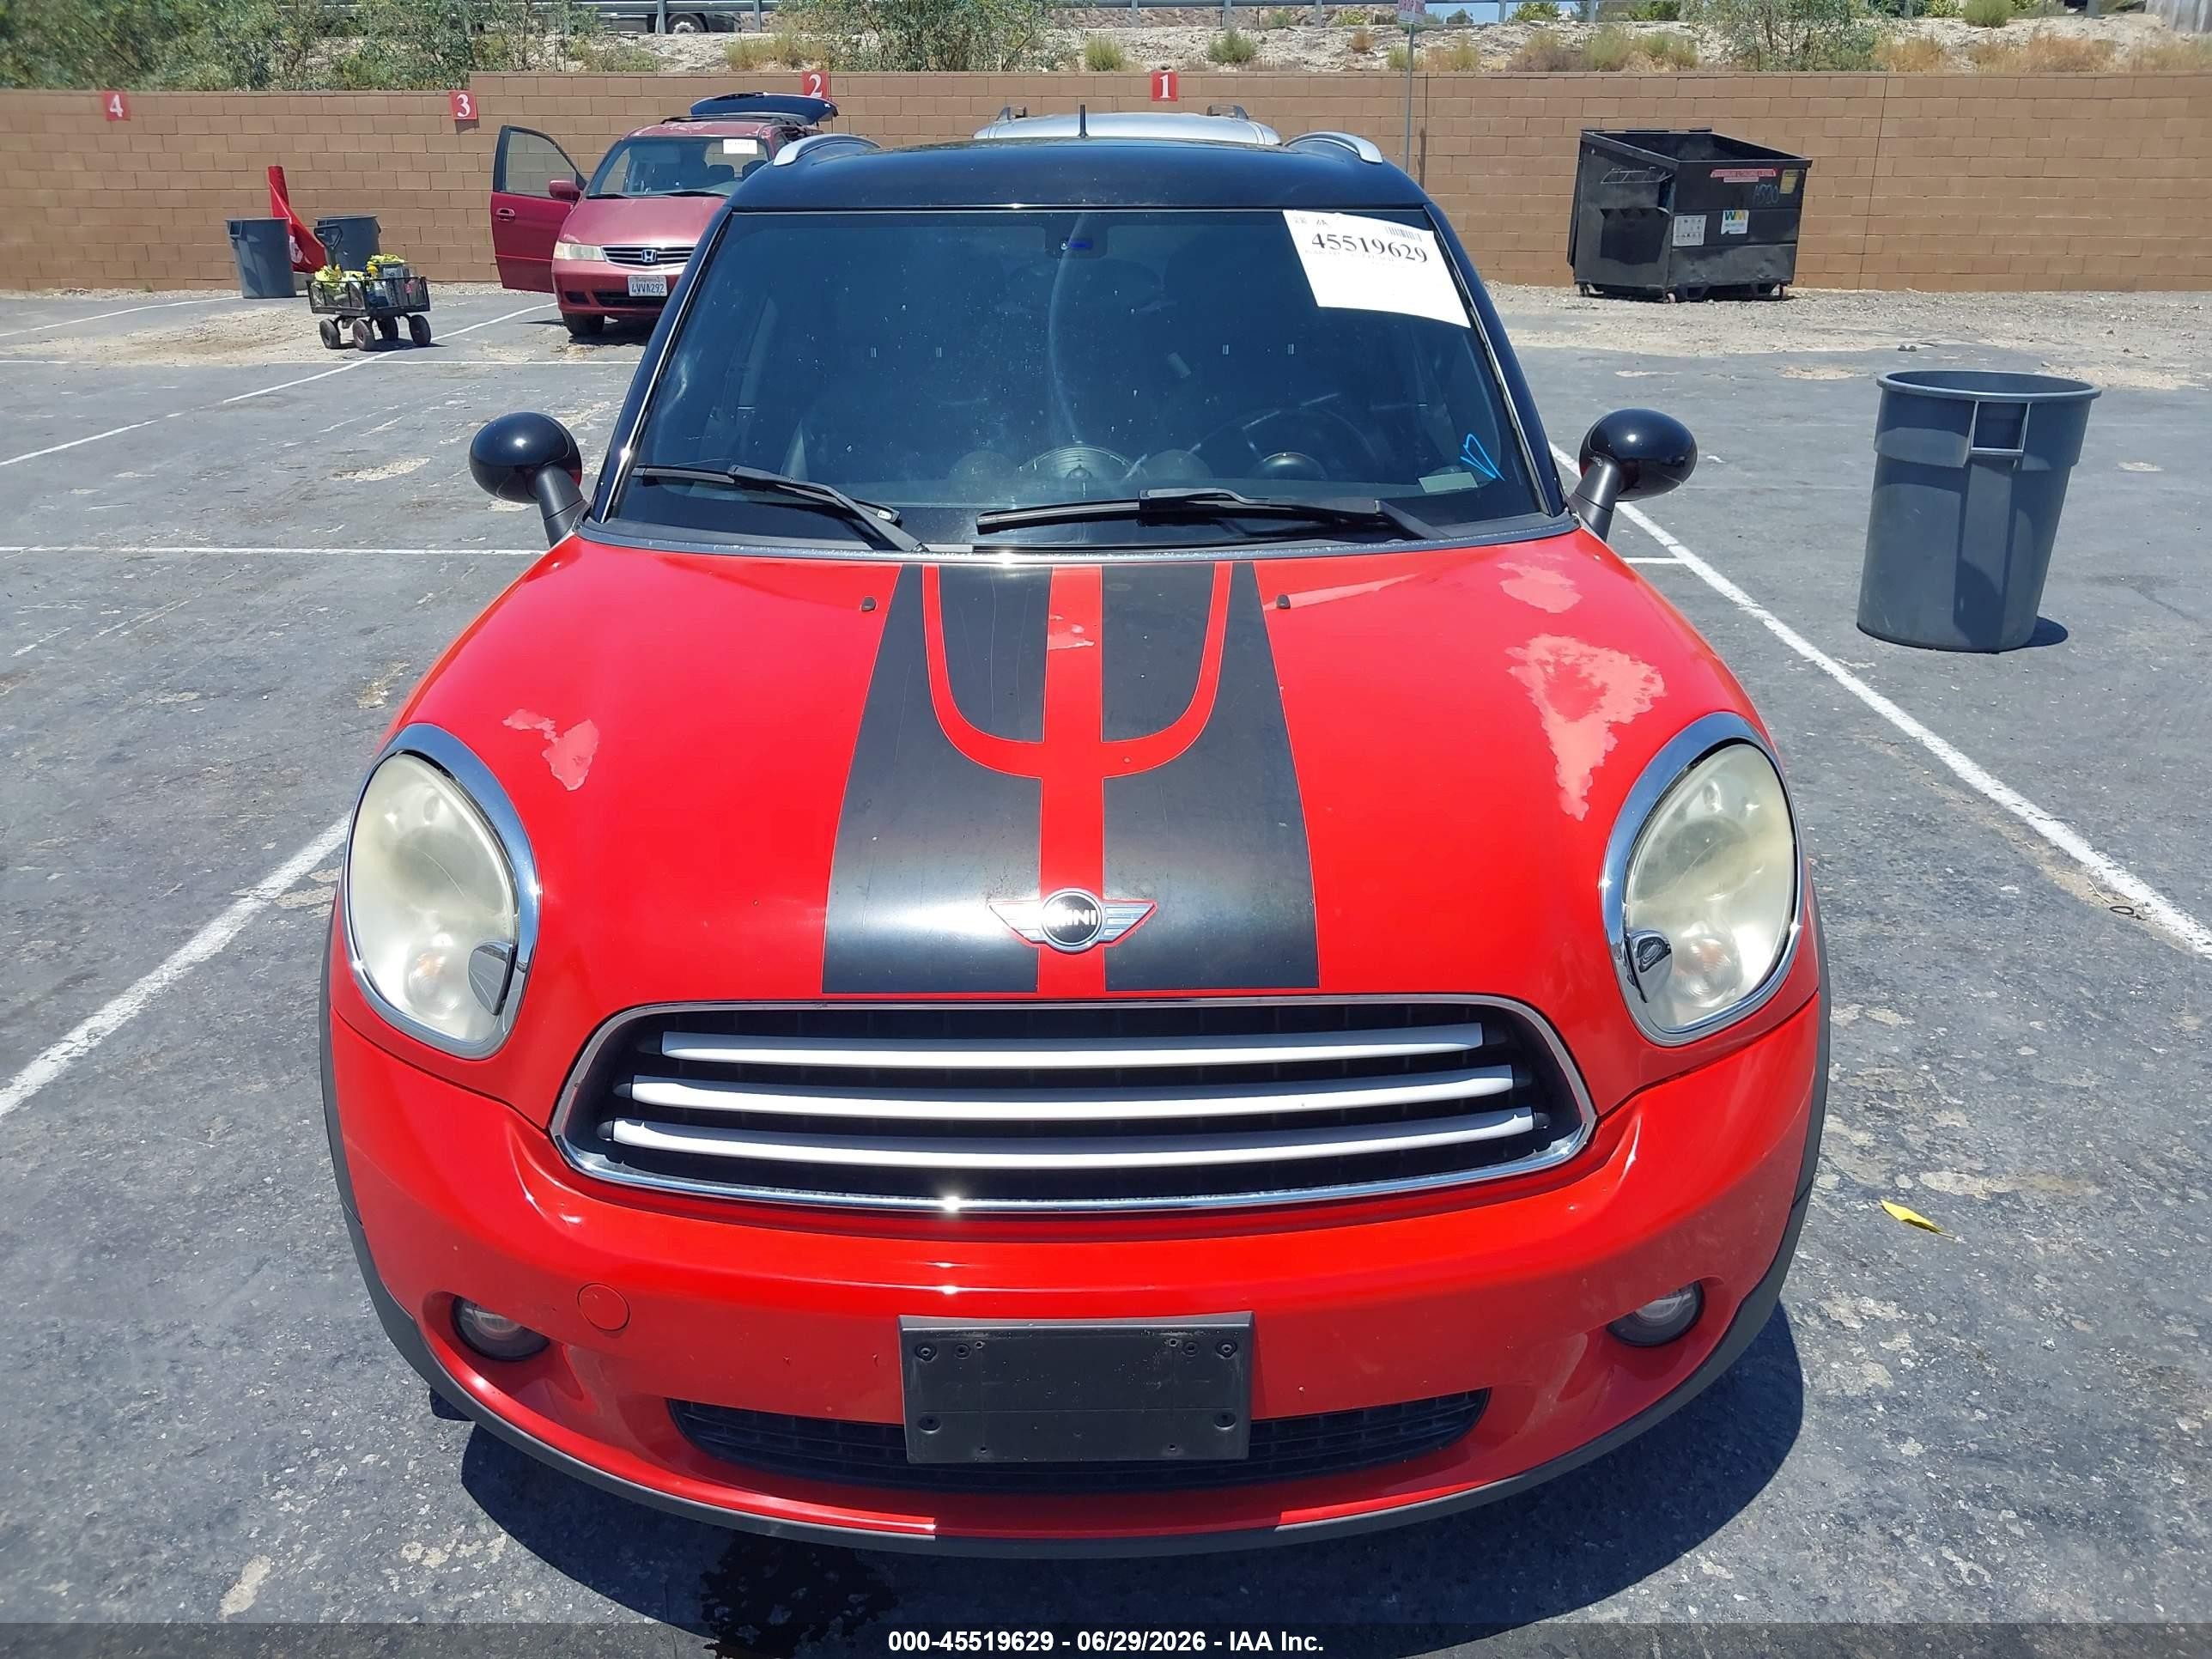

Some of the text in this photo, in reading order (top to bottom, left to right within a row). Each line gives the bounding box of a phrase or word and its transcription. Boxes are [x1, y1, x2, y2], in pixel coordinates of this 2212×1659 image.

[809, 74, 823, 98] 2
[1159, 74, 1171, 99] 1
[109, 94, 124, 118] 4
[456, 94, 471, 118] 3
[1724, 211, 1747, 221] WM
[1311, 233, 1428, 263] 45519629
